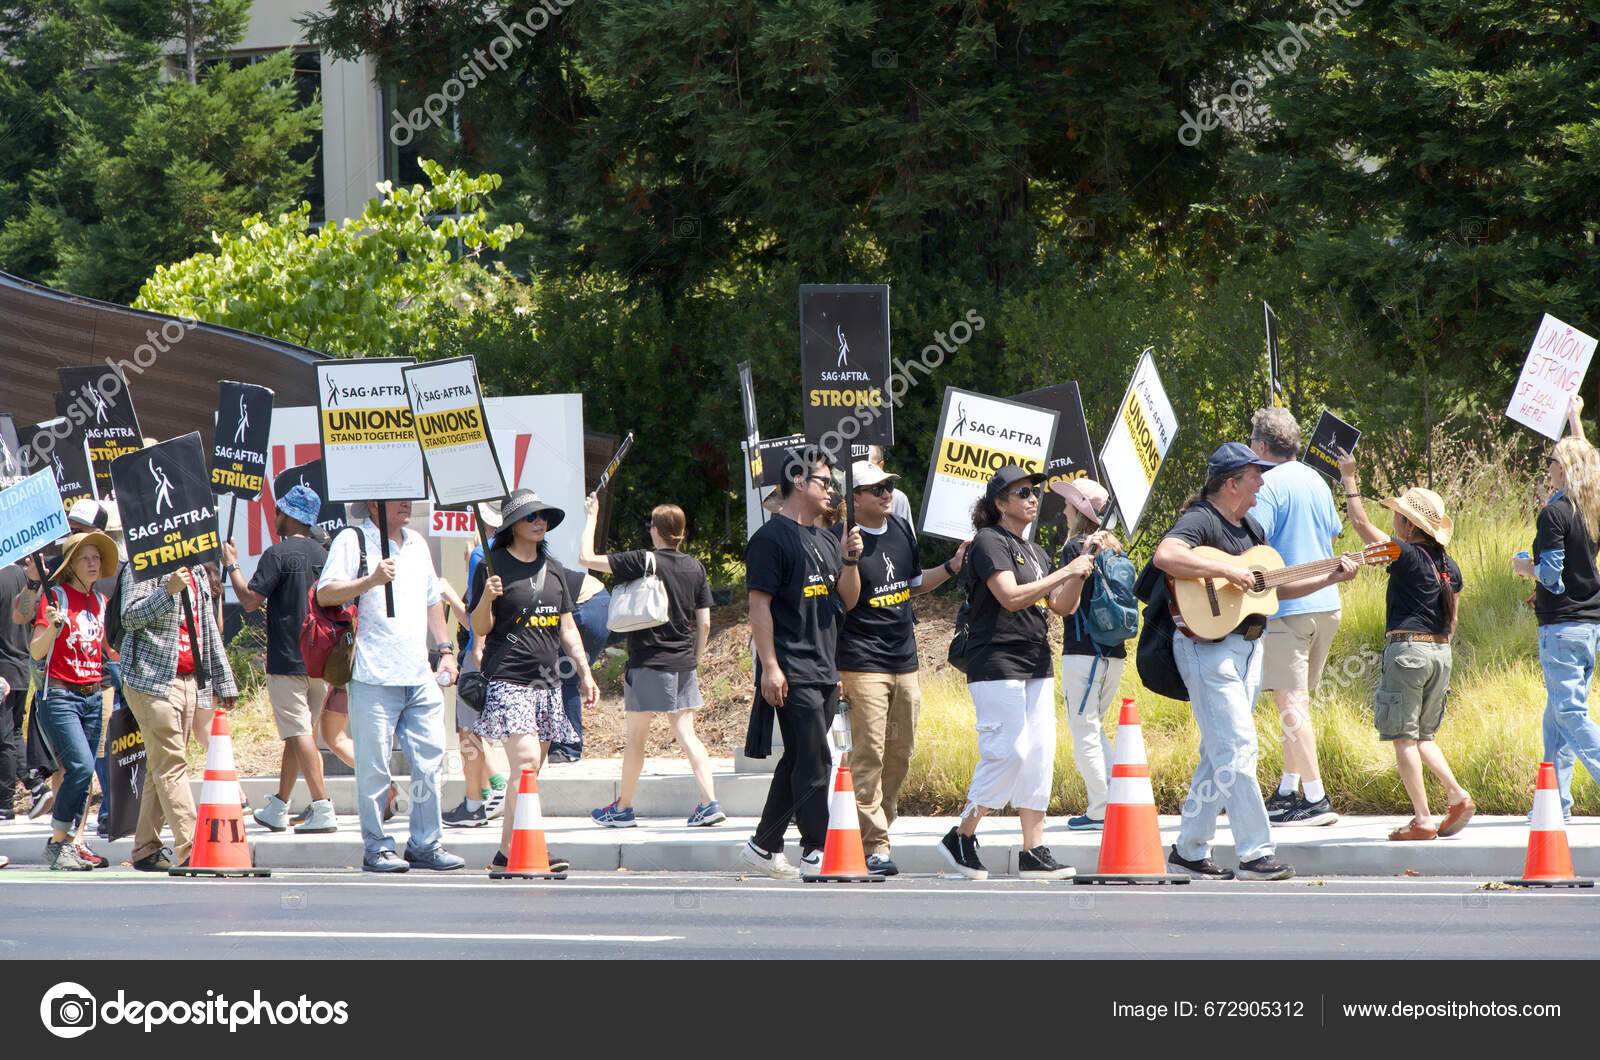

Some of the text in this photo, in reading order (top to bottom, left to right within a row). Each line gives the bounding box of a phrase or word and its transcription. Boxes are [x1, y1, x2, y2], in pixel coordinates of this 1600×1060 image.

[1538, 326, 1588, 363] UNION
[809, 389, 882, 407] STRONG
[328, 409, 413, 431] UNIONS
[419, 409, 479, 435] UNIONS
[330, 431, 414, 442] STAND TOGETHER
[424, 431, 482, 447] STAND TOGETHER
[1129, 394, 1160, 471] UNIONS
[232, 463, 244, 472] ON
[943, 463, 978, 479] STAND
[211, 468, 263, 491] STRIKE!
[164, 531, 181, 543] ON
[133, 531, 218, 571] STRIKE!
